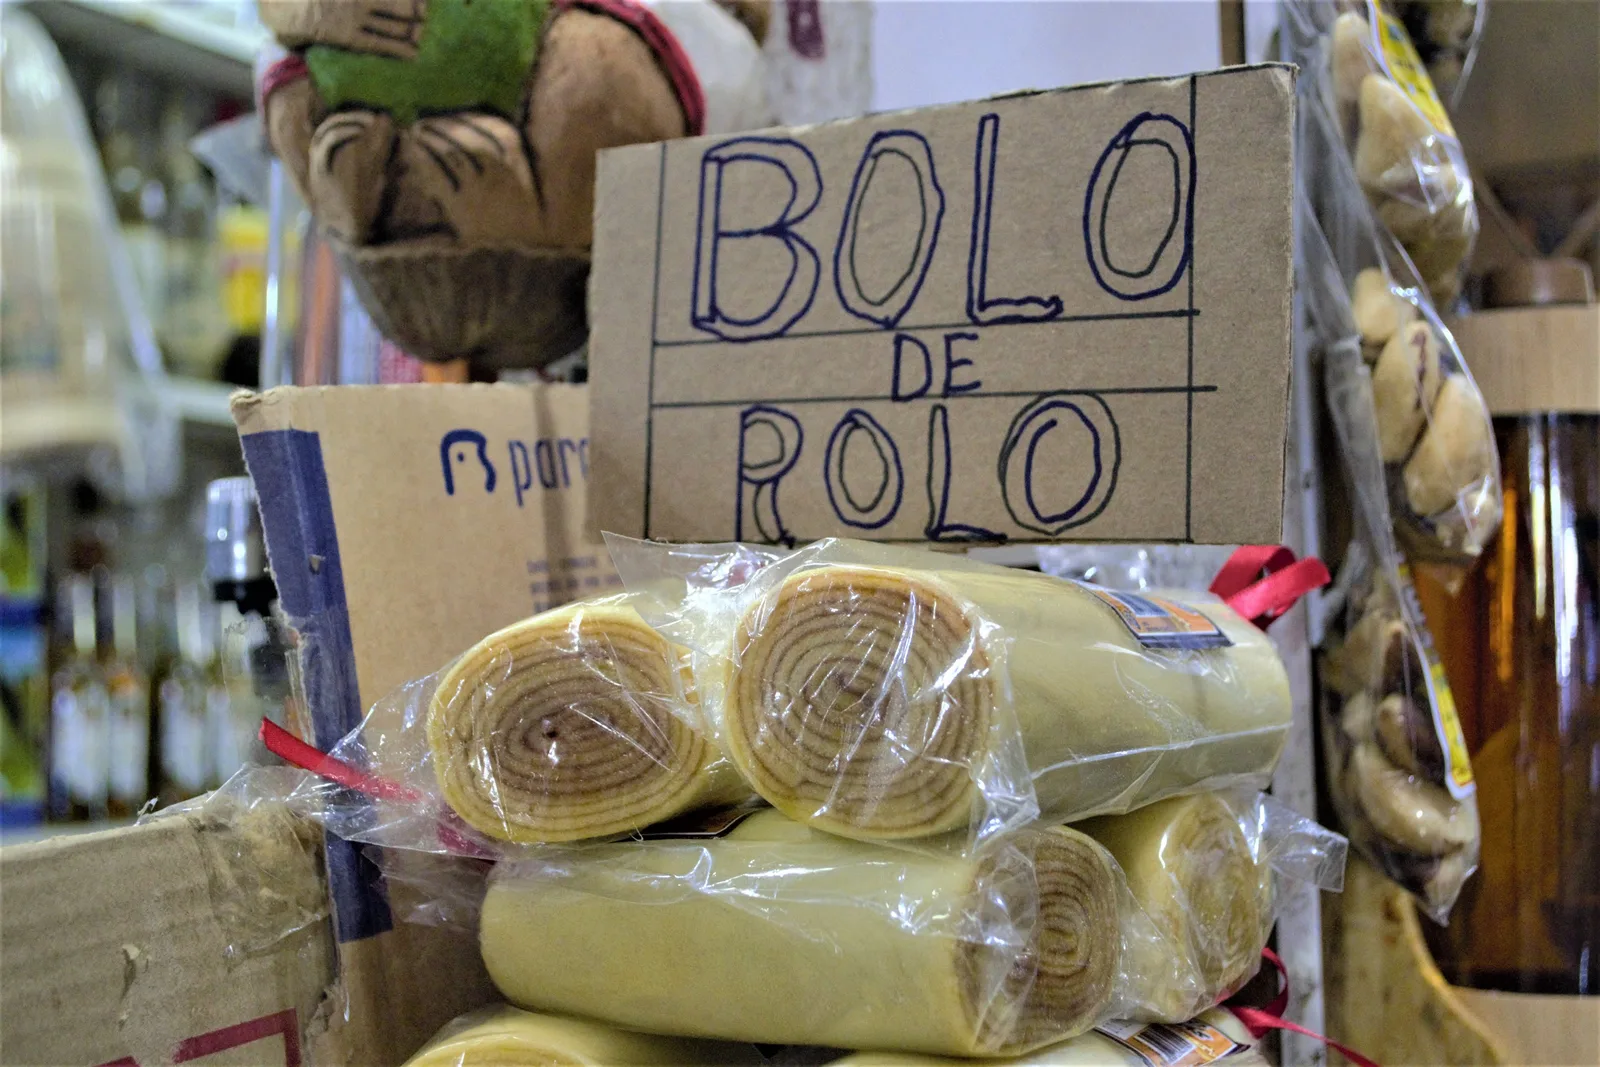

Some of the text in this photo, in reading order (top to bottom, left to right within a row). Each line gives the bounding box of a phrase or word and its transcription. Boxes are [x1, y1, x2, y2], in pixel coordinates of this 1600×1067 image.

[692, 112, 1195, 341] BOLO
[892, 332, 982, 401] DE
[735, 391, 1121, 545] ROLO
